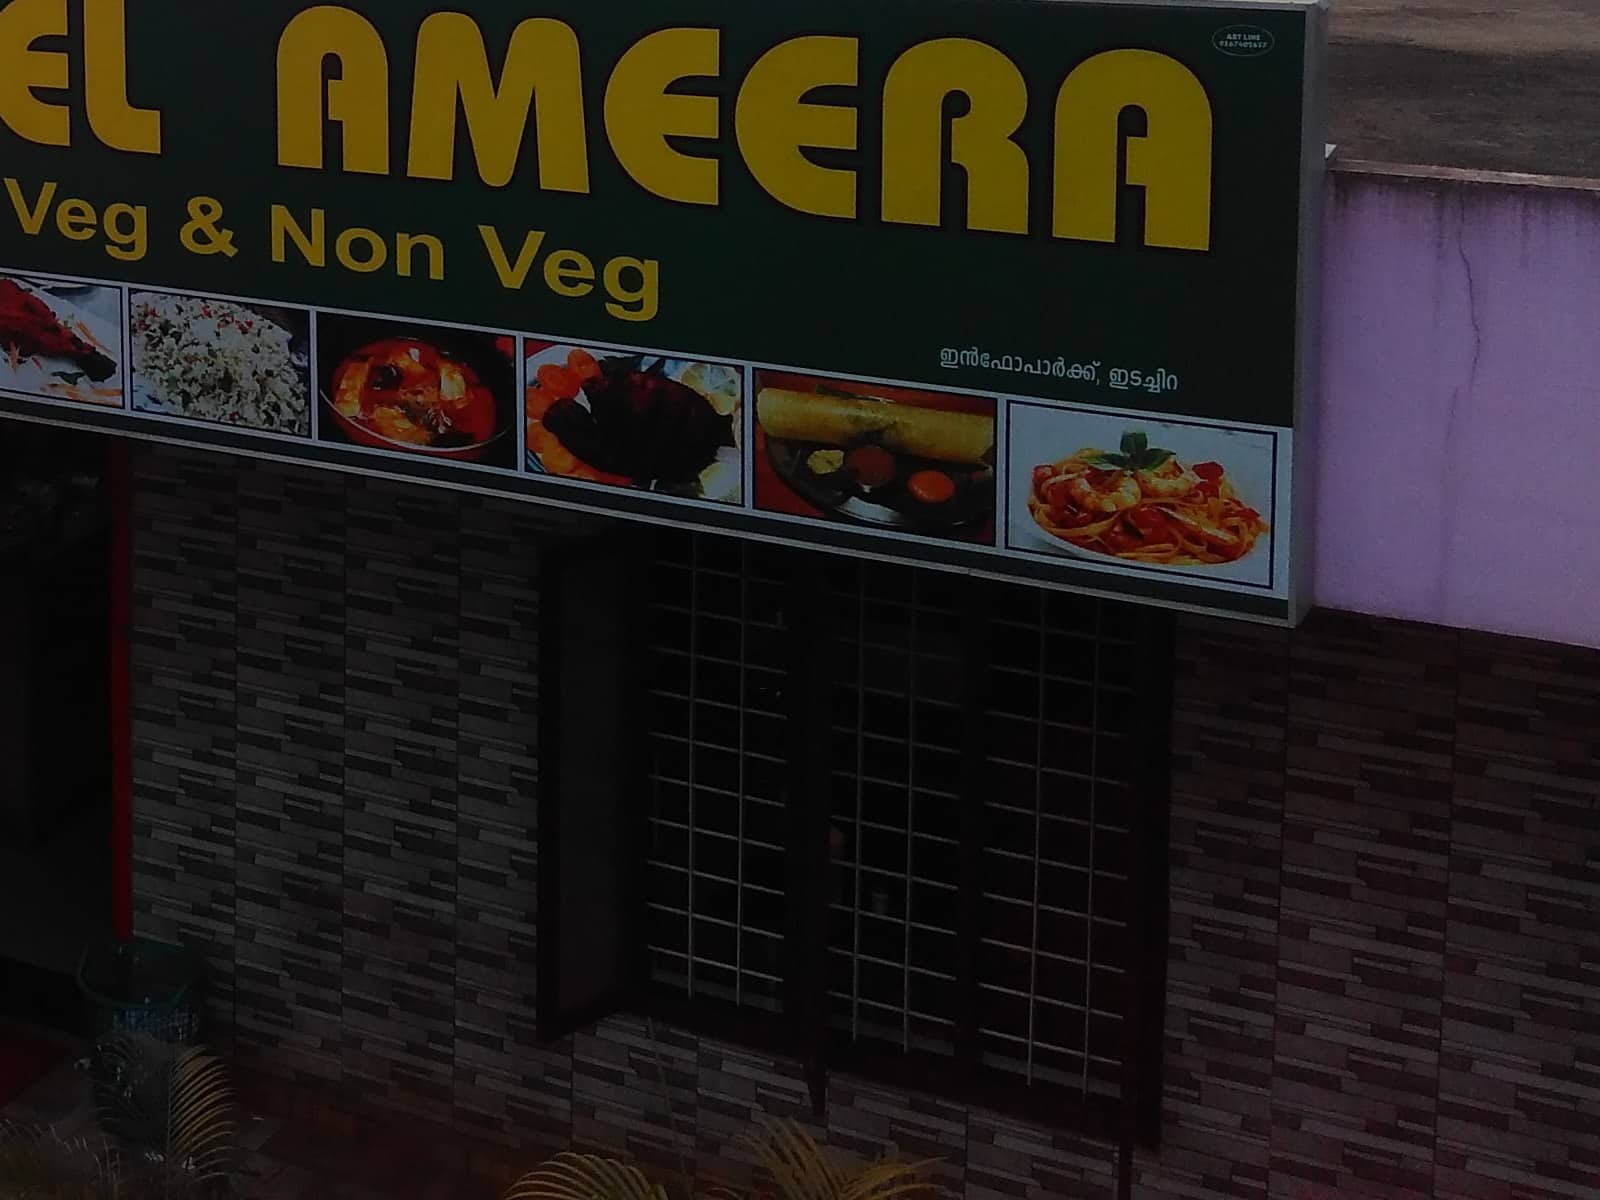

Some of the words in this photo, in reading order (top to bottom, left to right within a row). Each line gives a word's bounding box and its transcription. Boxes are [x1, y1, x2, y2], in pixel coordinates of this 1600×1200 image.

[276, 5, 1214, 252] AMEERA
[3, 177, 148, 261] Veg
[179, 196, 239, 259] &
[270, 204, 445, 281] Non
[477, 223, 660, 322] Veg
[1108, 366, 1179, 394] ഇടച്ചിറ
